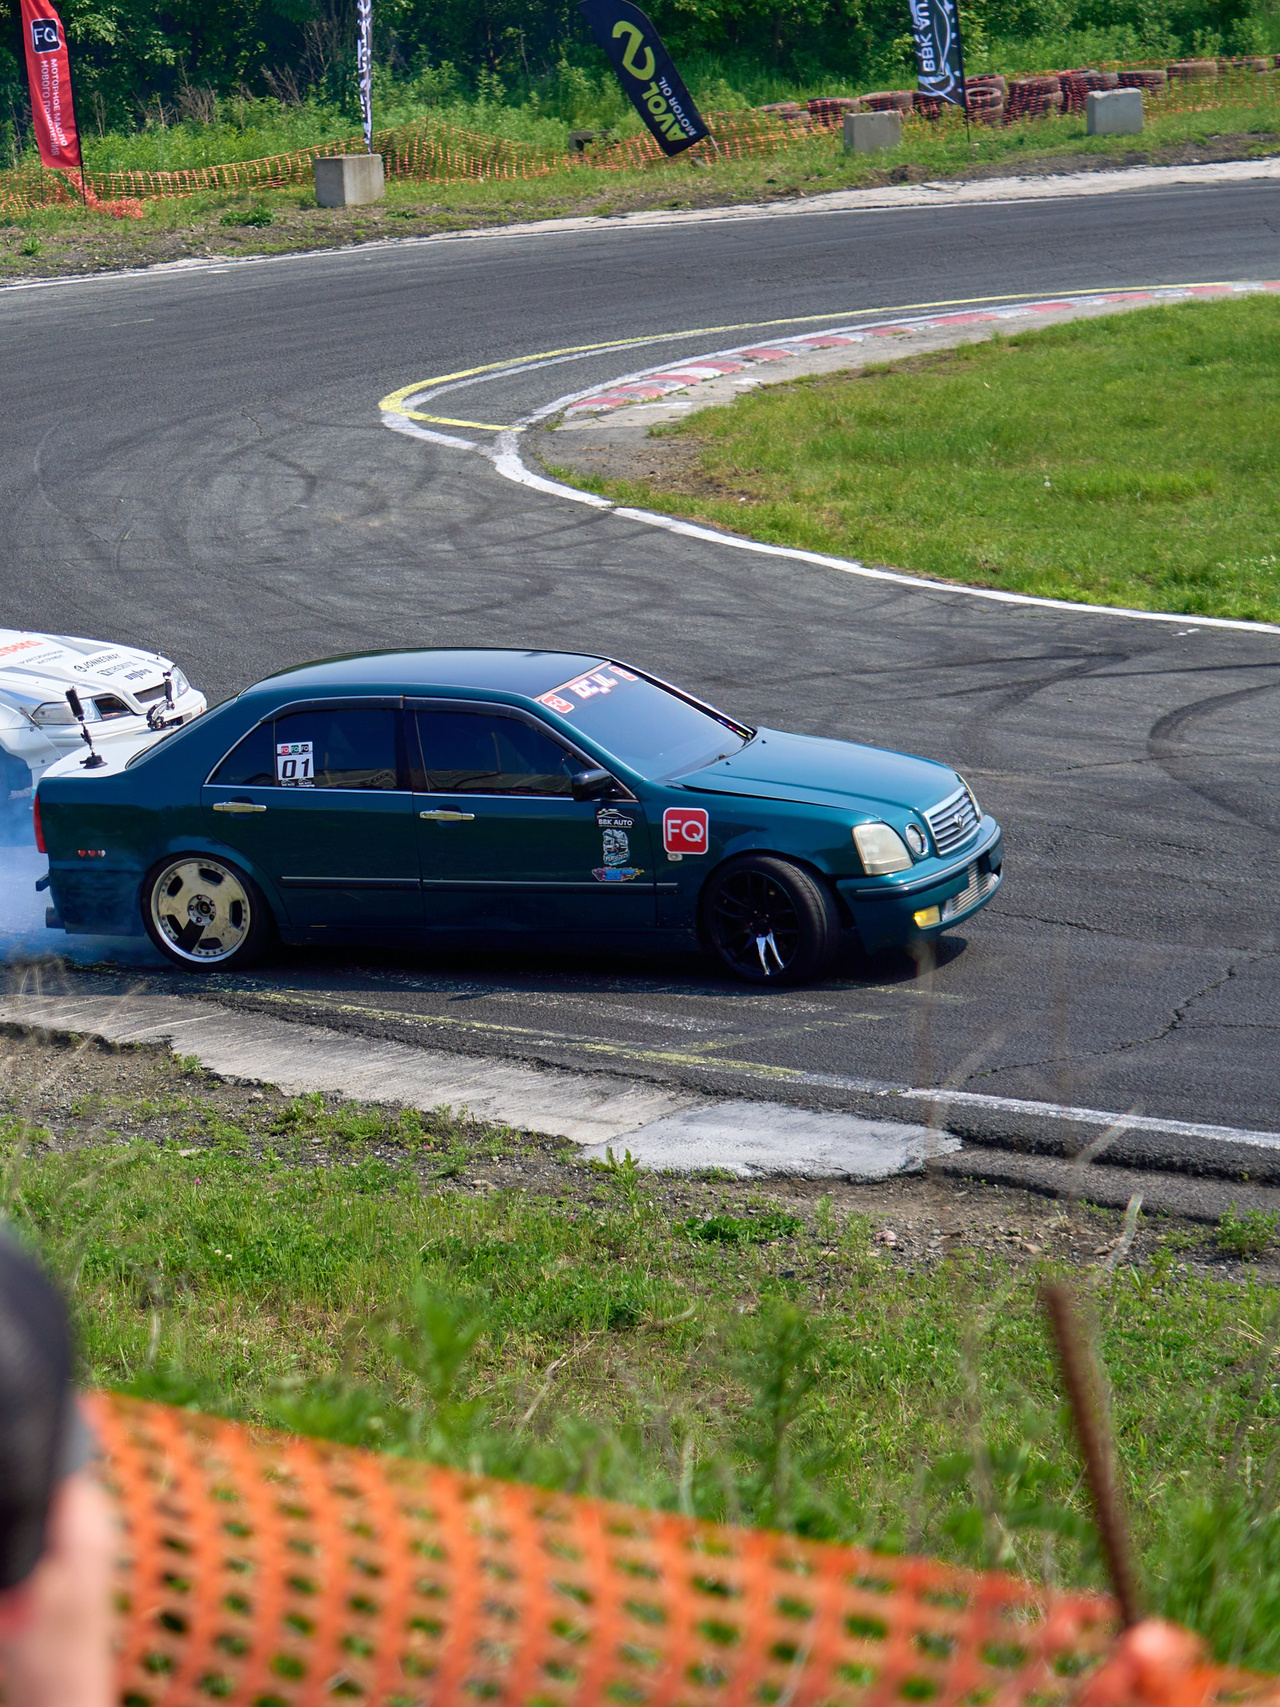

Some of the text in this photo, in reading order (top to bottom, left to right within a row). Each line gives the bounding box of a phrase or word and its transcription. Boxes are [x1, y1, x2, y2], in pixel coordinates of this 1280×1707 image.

[33, 27, 57, 45] FQ
[40, 60, 60, 156] НОВОГО ПОКОЛЕНИЯ
[50, 59, 68, 147] МОТОРНОЕ МАСЛО
[642, 82, 688, 141] AVOL
[658, 76, 697, 137] MOTOR OIL
[282, 759, 310, 778] 01
[667, 820, 704, 842] FQ
